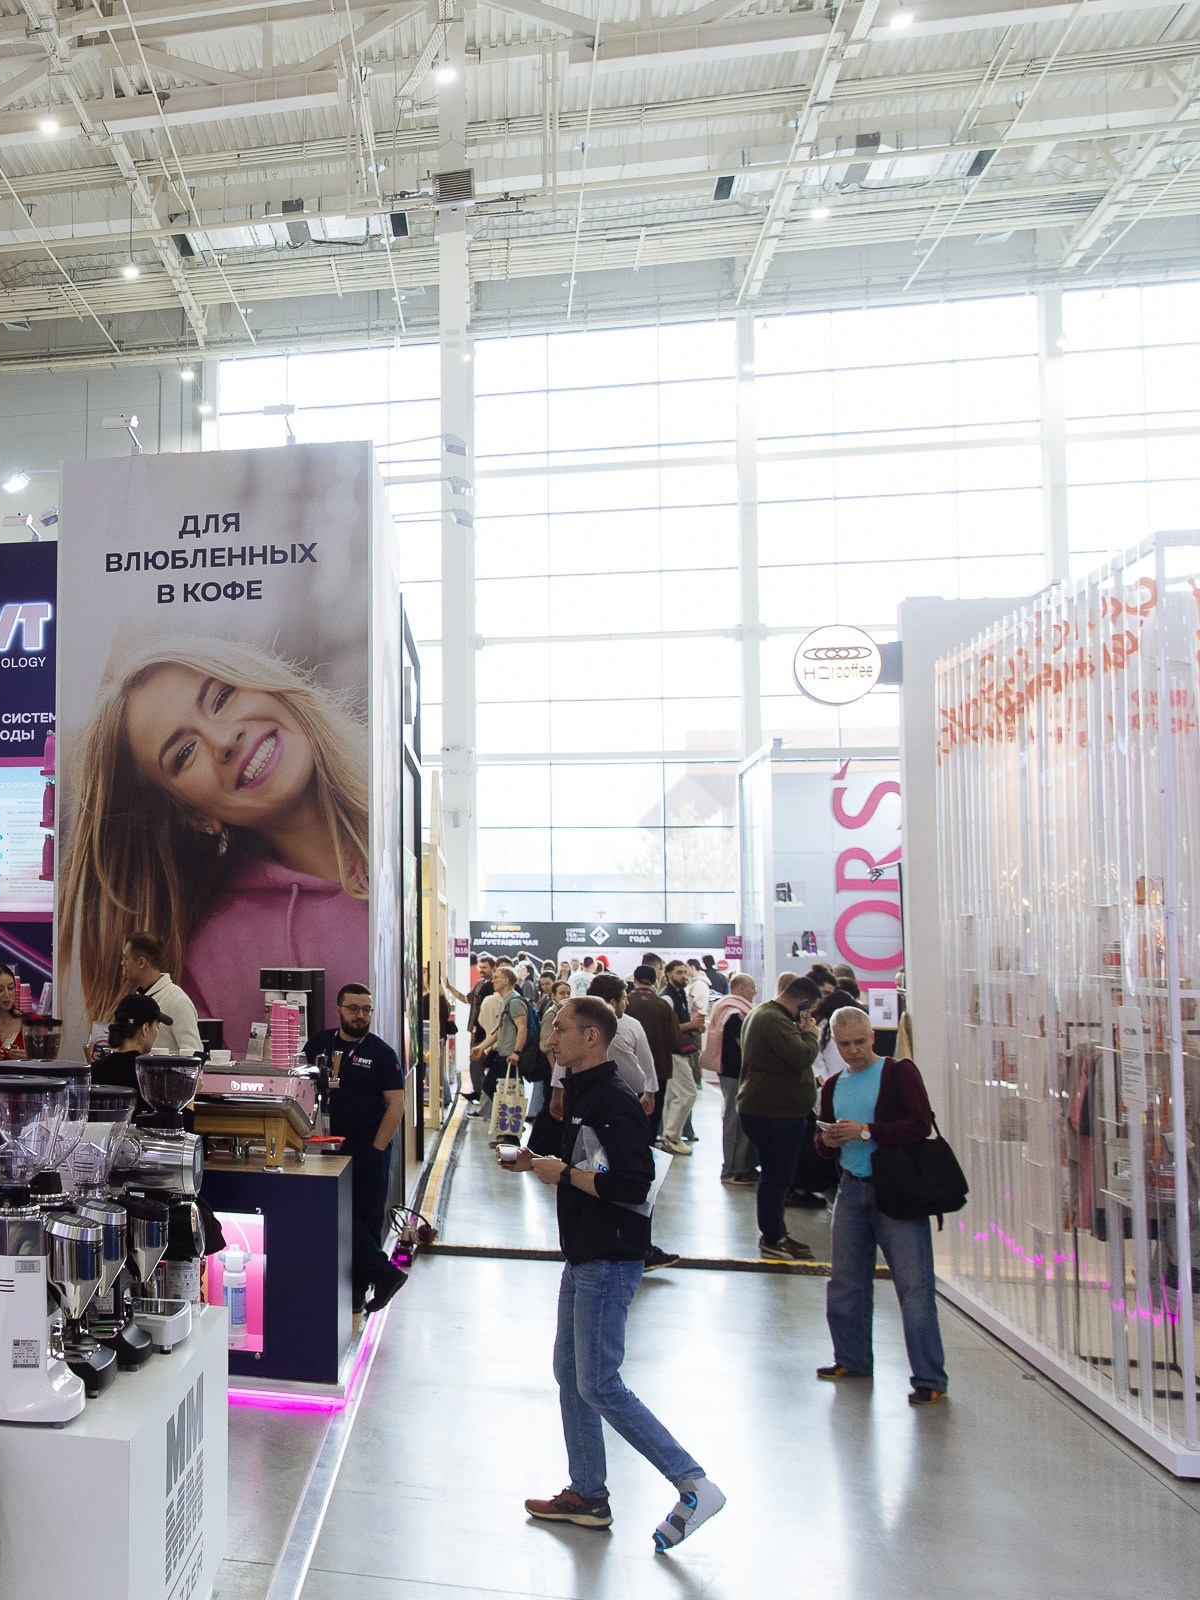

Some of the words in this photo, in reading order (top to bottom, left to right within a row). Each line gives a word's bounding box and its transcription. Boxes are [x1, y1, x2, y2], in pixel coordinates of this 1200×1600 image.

[178, 512, 240, 539] ДЛЯ
[105, 543, 318, 573] ВЛЮБЛЕННЫХ
[157, 584, 175, 604] В
[183, 580, 263, 603] КОФЕ
